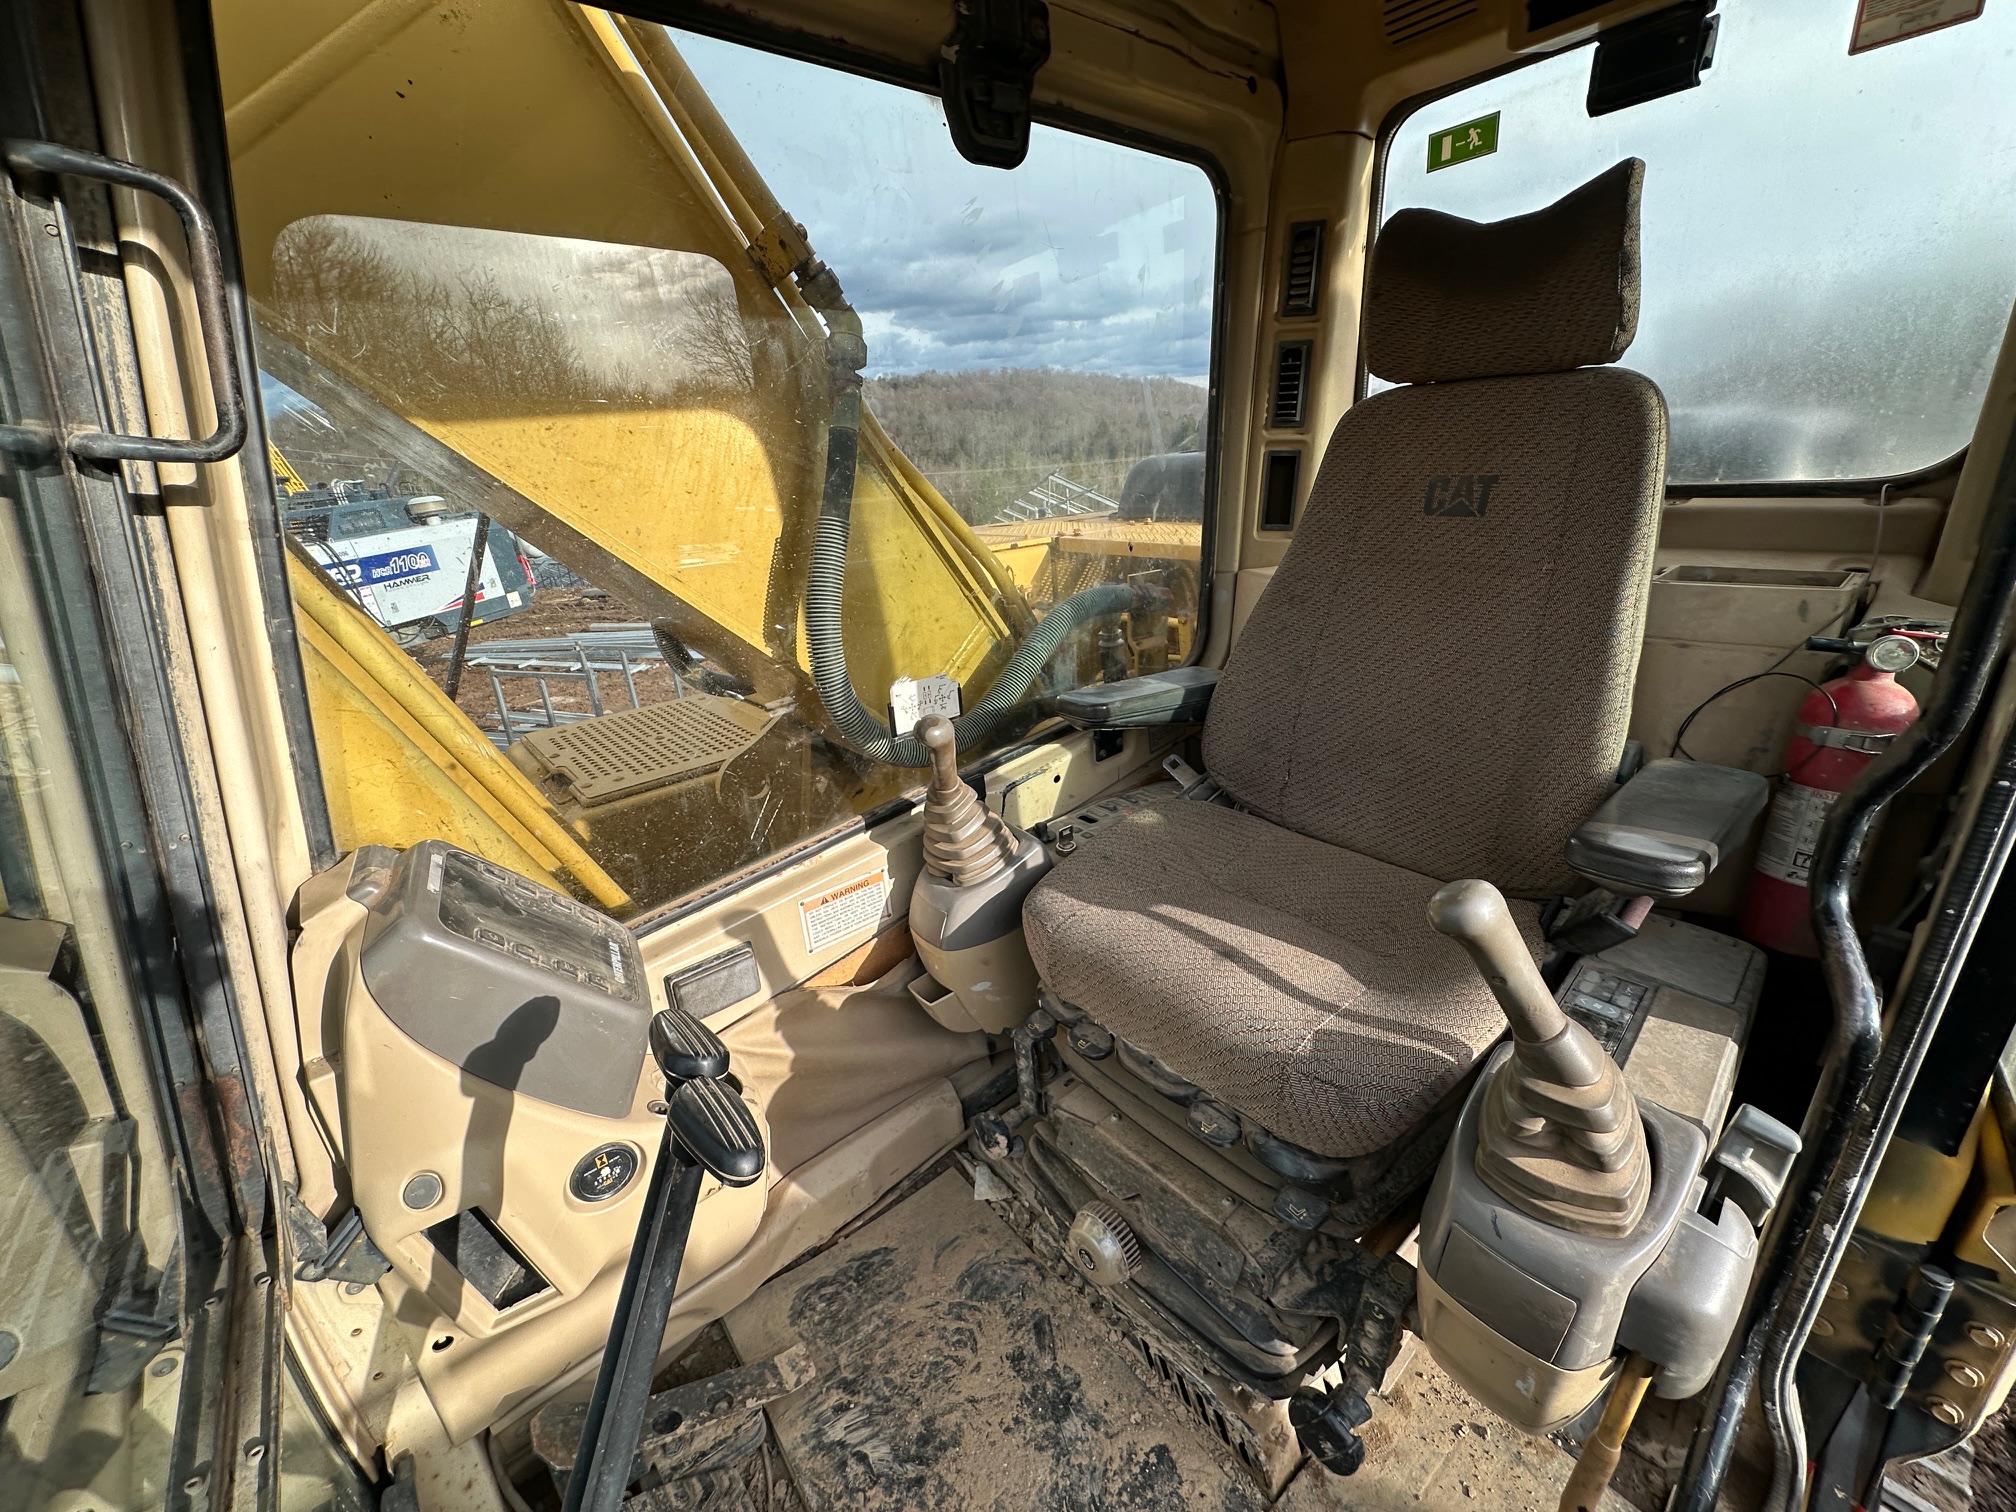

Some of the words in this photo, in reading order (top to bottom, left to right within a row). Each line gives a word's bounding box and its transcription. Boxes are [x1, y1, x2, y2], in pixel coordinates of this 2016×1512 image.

[1423, 475, 1499, 517] CAT
[384, 574, 431, 592] HAMMER
[830, 879, 870, 901] WARNING
[608, 941, 625, 984] CATERPILLAR
